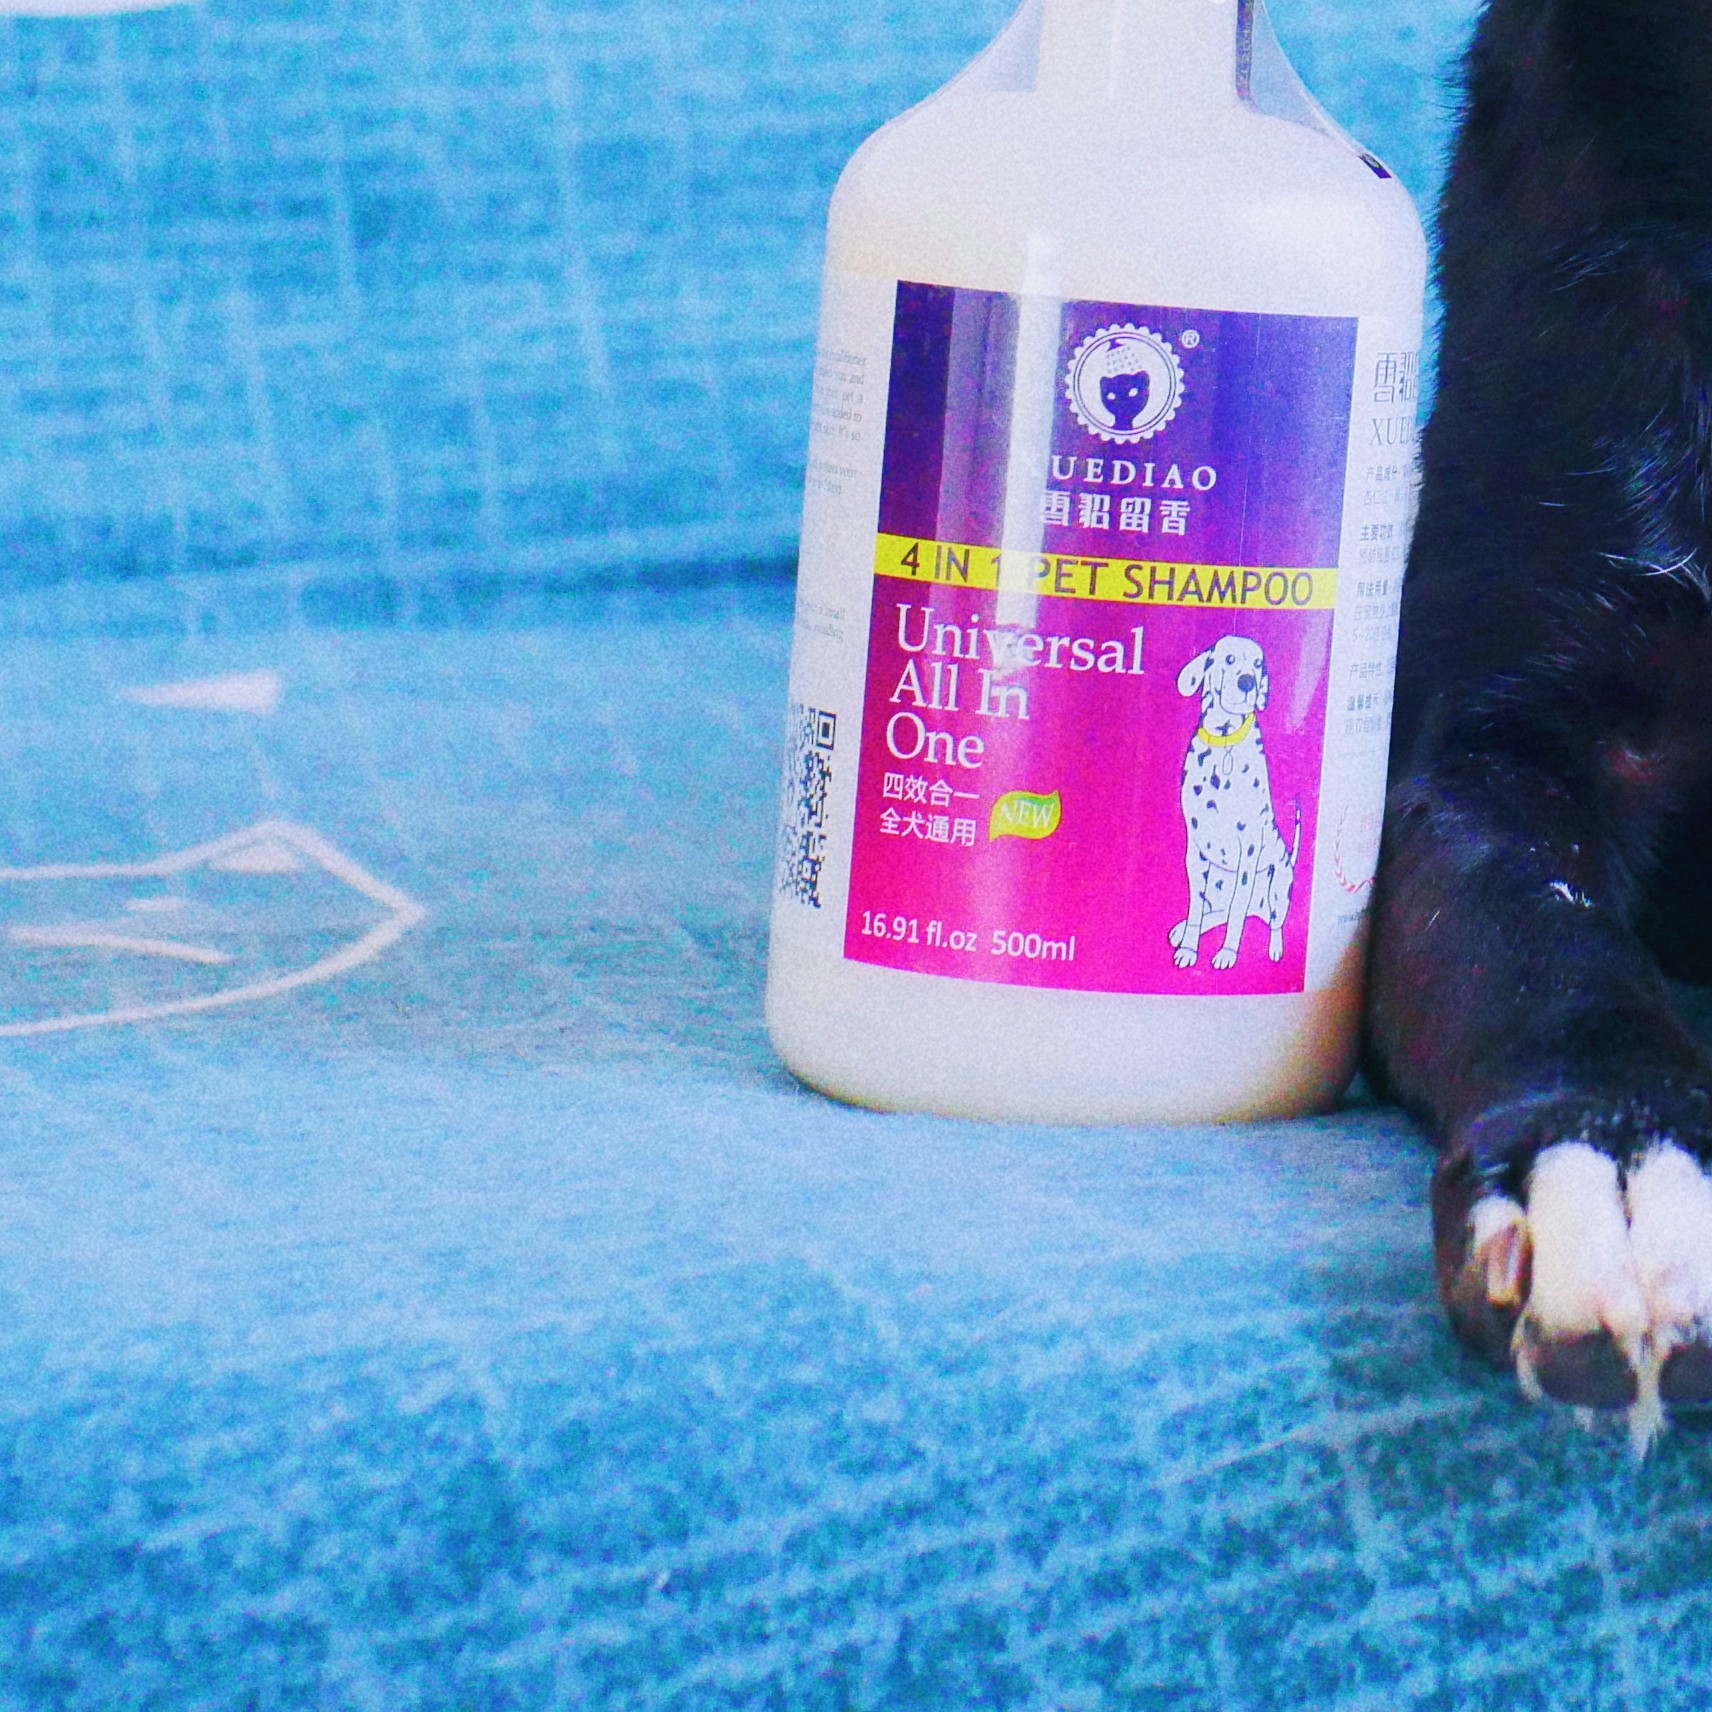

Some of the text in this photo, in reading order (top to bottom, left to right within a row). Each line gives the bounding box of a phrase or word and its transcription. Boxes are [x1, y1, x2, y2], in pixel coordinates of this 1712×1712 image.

[1050, 455, 1217, 491] UEDIAO
[1043, 490, 1191, 536] 雪貂留香
[900, 542, 1314, 606] 4 IN 1 PET SHAMPOO
[896, 603, 1145, 675] Universal
[889, 658, 1030, 720] All In
[886, 711, 985, 769] One
[883, 772, 980, 808] 四效合一
[1001, 799, 1055, 829] NEW
[879, 807, 977, 847] 全犬通用
[861, 910, 1075, 961] 16.91 fl.oz 500ml
